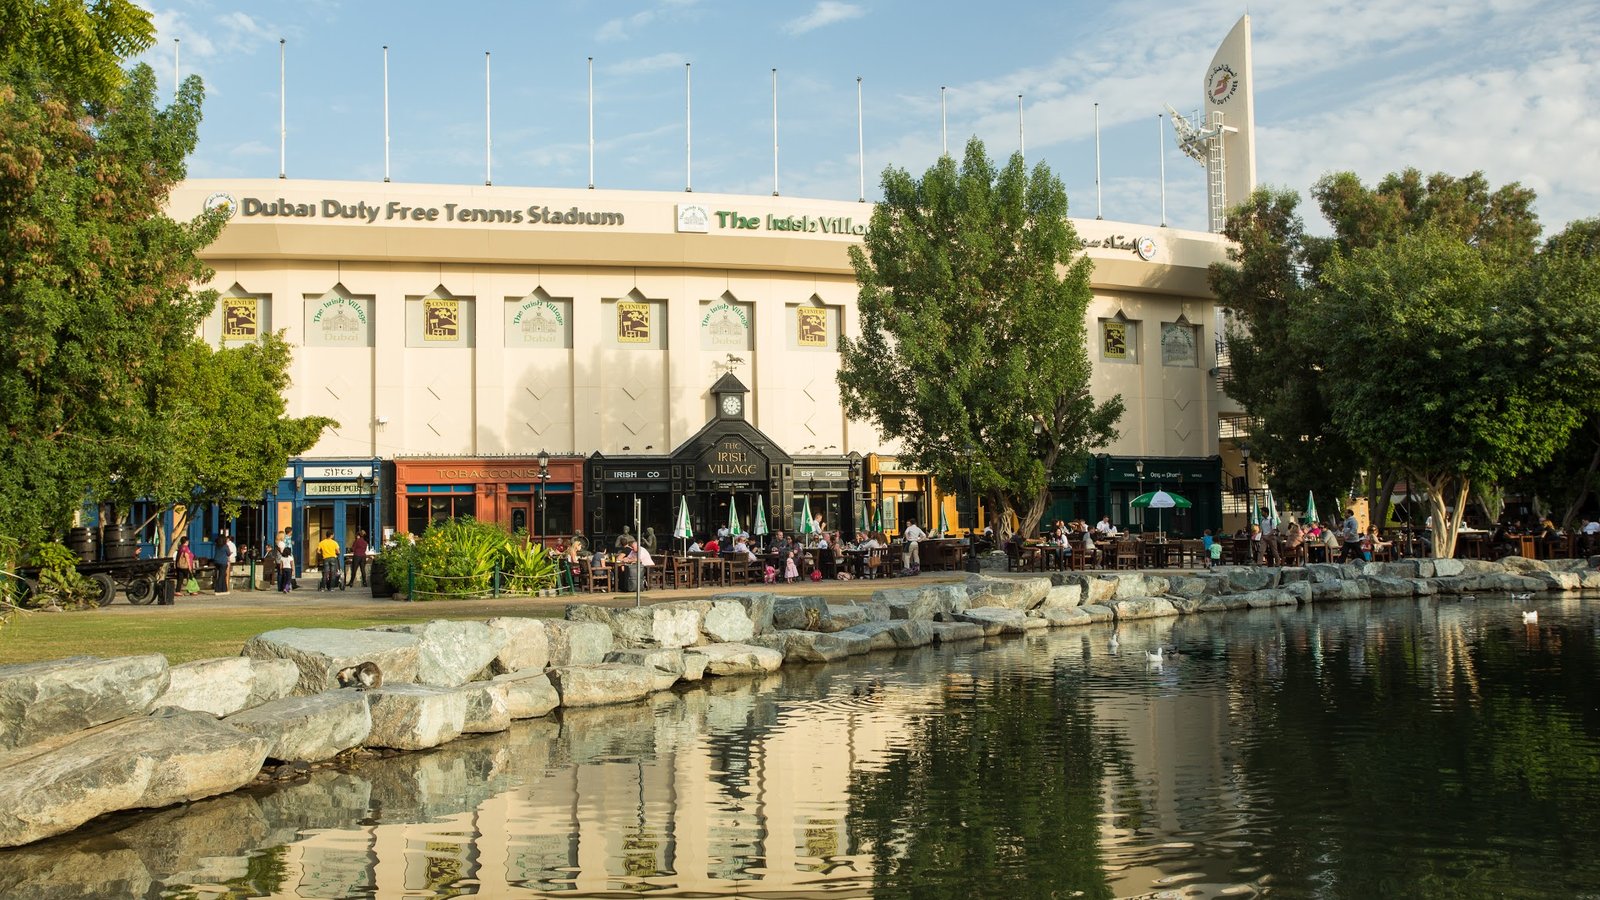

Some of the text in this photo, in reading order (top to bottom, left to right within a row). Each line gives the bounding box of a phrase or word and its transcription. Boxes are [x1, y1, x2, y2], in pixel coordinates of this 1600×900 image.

[1229, 80, 1238, 96] FREE
[241, 198, 316, 218] Dubai
[321, 199, 380, 224] Duty
[385, 201, 440, 222] Free
[443, 203, 524, 224] Tennis
[526, 205, 625, 226] Stadium
[714, 210, 872, 237] The Irish Villa
[313, 297, 367, 325] The Irish Village
[513, 299, 564, 326] The Irish Village
[702, 303, 749, 329] The Irish Village
[723, 442, 742, 450] THE
[718, 452, 747, 462] IRISH
[436, 468, 547, 480] TOBACCONIS
[707, 464, 757, 477] VILLAGE
[318, 485, 361, 493] IRISH PUB
